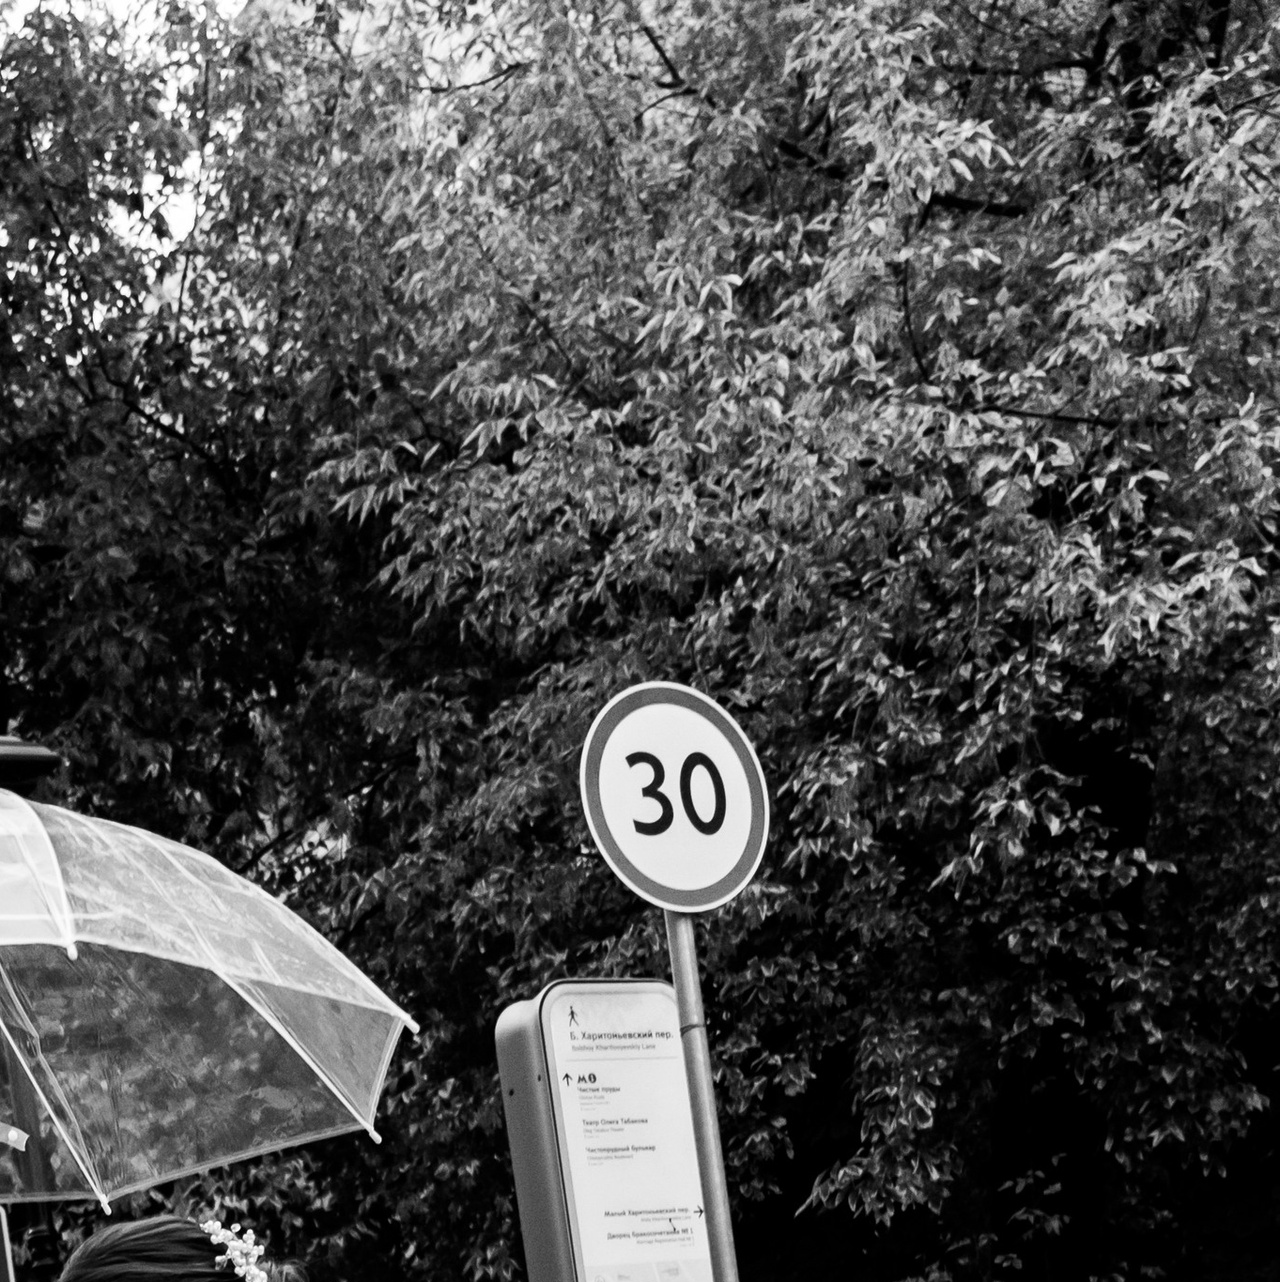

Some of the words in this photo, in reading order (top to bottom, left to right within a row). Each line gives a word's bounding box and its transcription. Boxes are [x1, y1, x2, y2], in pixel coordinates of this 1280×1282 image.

[625, 751, 727, 836] 30
[570, 1031, 579, 1041] Б.
[581, 1030, 653, 1041] Харитоньевский
[655, 1031, 674, 1041] пер.
